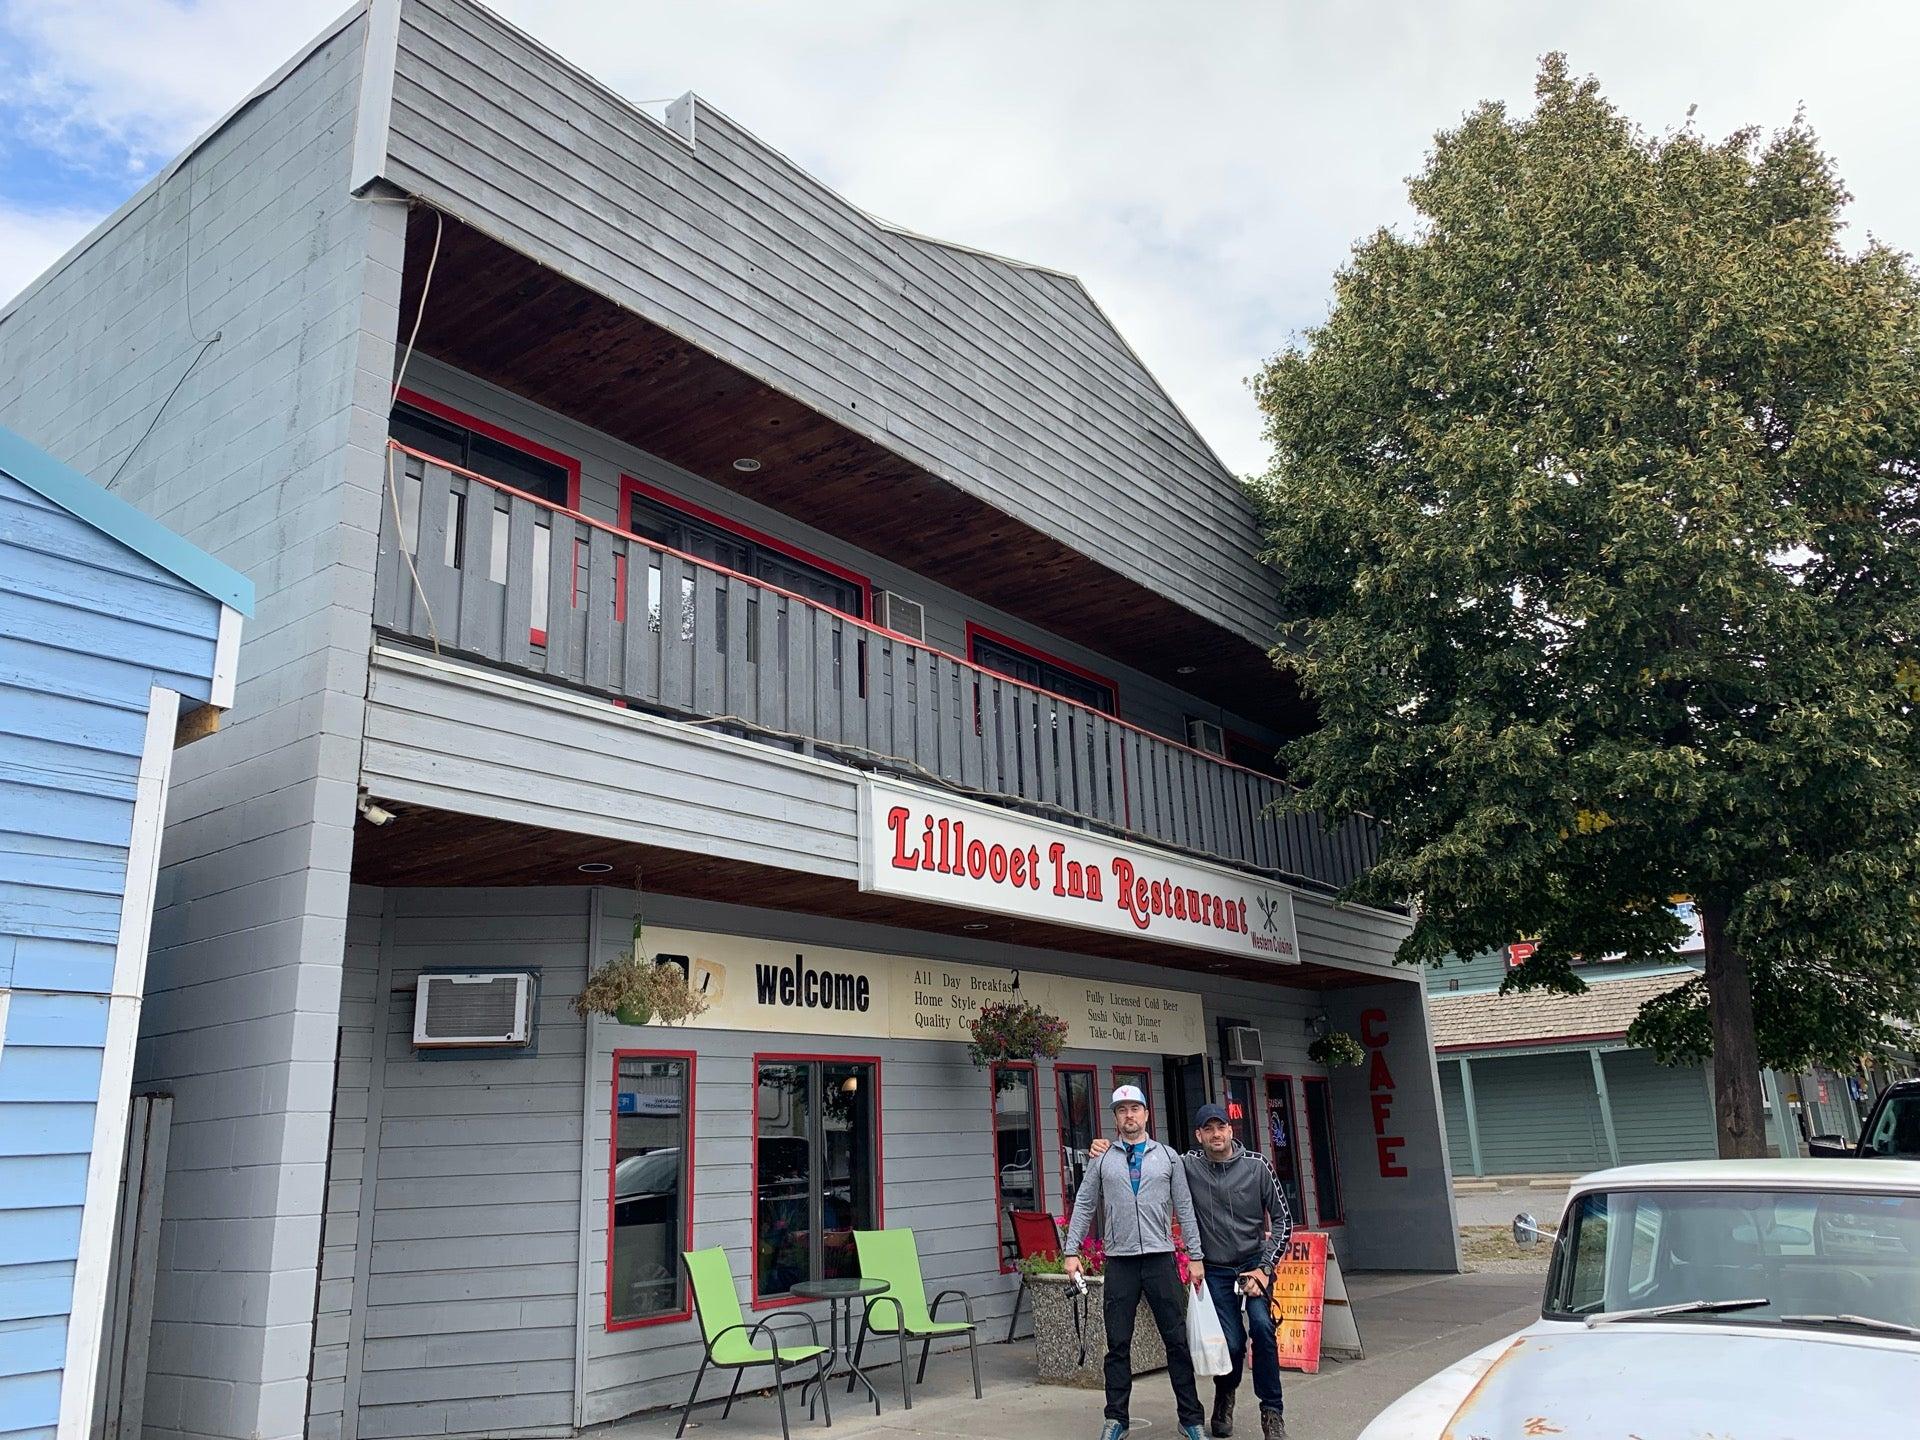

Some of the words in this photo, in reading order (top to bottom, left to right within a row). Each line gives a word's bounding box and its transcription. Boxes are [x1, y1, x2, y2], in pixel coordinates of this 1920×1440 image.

[888, 806, 1041, 891] Lillooet
[1049, 842, 1104, 902] Inn
[1112, 857, 1249, 935] Restaurant
[1250, 931, 1273, 951] Western
[1272, 935, 1293, 955] Cuisine
[755, 953, 870, 1012] welcome
[914, 970, 931, 985] All
[943, 973, 961, 989] Day
[914, 991, 943, 1006] Home
[951, 994, 977, 1011] Style
[1086, 990, 1105, 1006] Fully
[1110, 992, 1141, 1008] Licensed
[1144, 997, 1160, 1010] Cold
[1163, 999, 1178, 1012] Beer
[914, 1012, 951, 1030] Quality
[1088, 1008, 1108, 1023] Sushi
[1112, 1011, 1132, 1026] Night
[1137, 1014, 1161, 1028] Dinner
[1089, 1025, 1126, 1041] Take-Out
[1134, 1029, 1159, 1043] Eat-In
[1360, 1008, 1408, 1178] CAFE
[1228, 1103, 1243, 1120] PEN
[1285, 1241, 1311, 1261] PEN
[1276, 1265, 1316, 1276] EAKFAST
[1290, 1282, 1306, 1292] DAY
[1281, 1304, 1321, 1315] LUNCHES
[1290, 1328, 1306, 1338] OUT
[1292, 1344, 1303, 1353] IN
